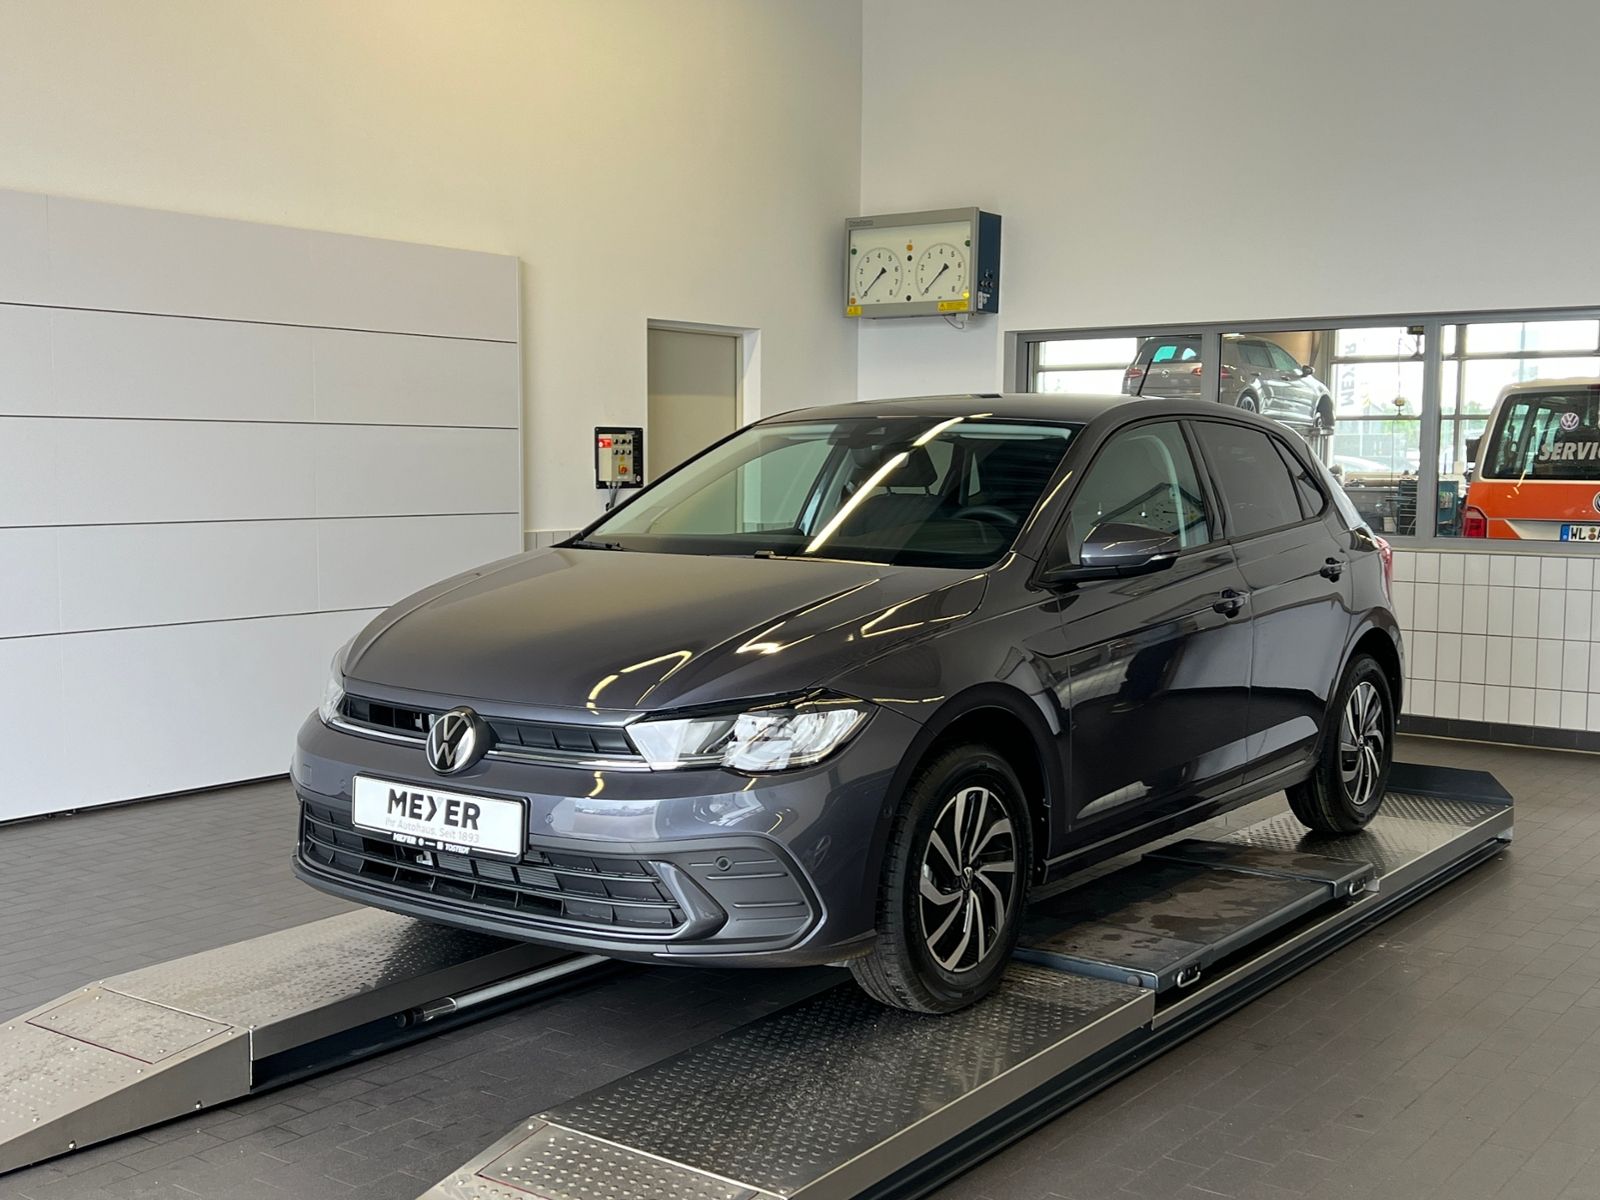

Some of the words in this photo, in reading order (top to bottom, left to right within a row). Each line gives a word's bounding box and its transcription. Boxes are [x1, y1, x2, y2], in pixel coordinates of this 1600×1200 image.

[1539, 441, 1600, 461] SERVI
[1571, 527, 1586, 540] WL
[387, 788, 481, 831] MEYER
[439, 827, 456, 840] Seit
[458, 831, 480, 844] 1893
